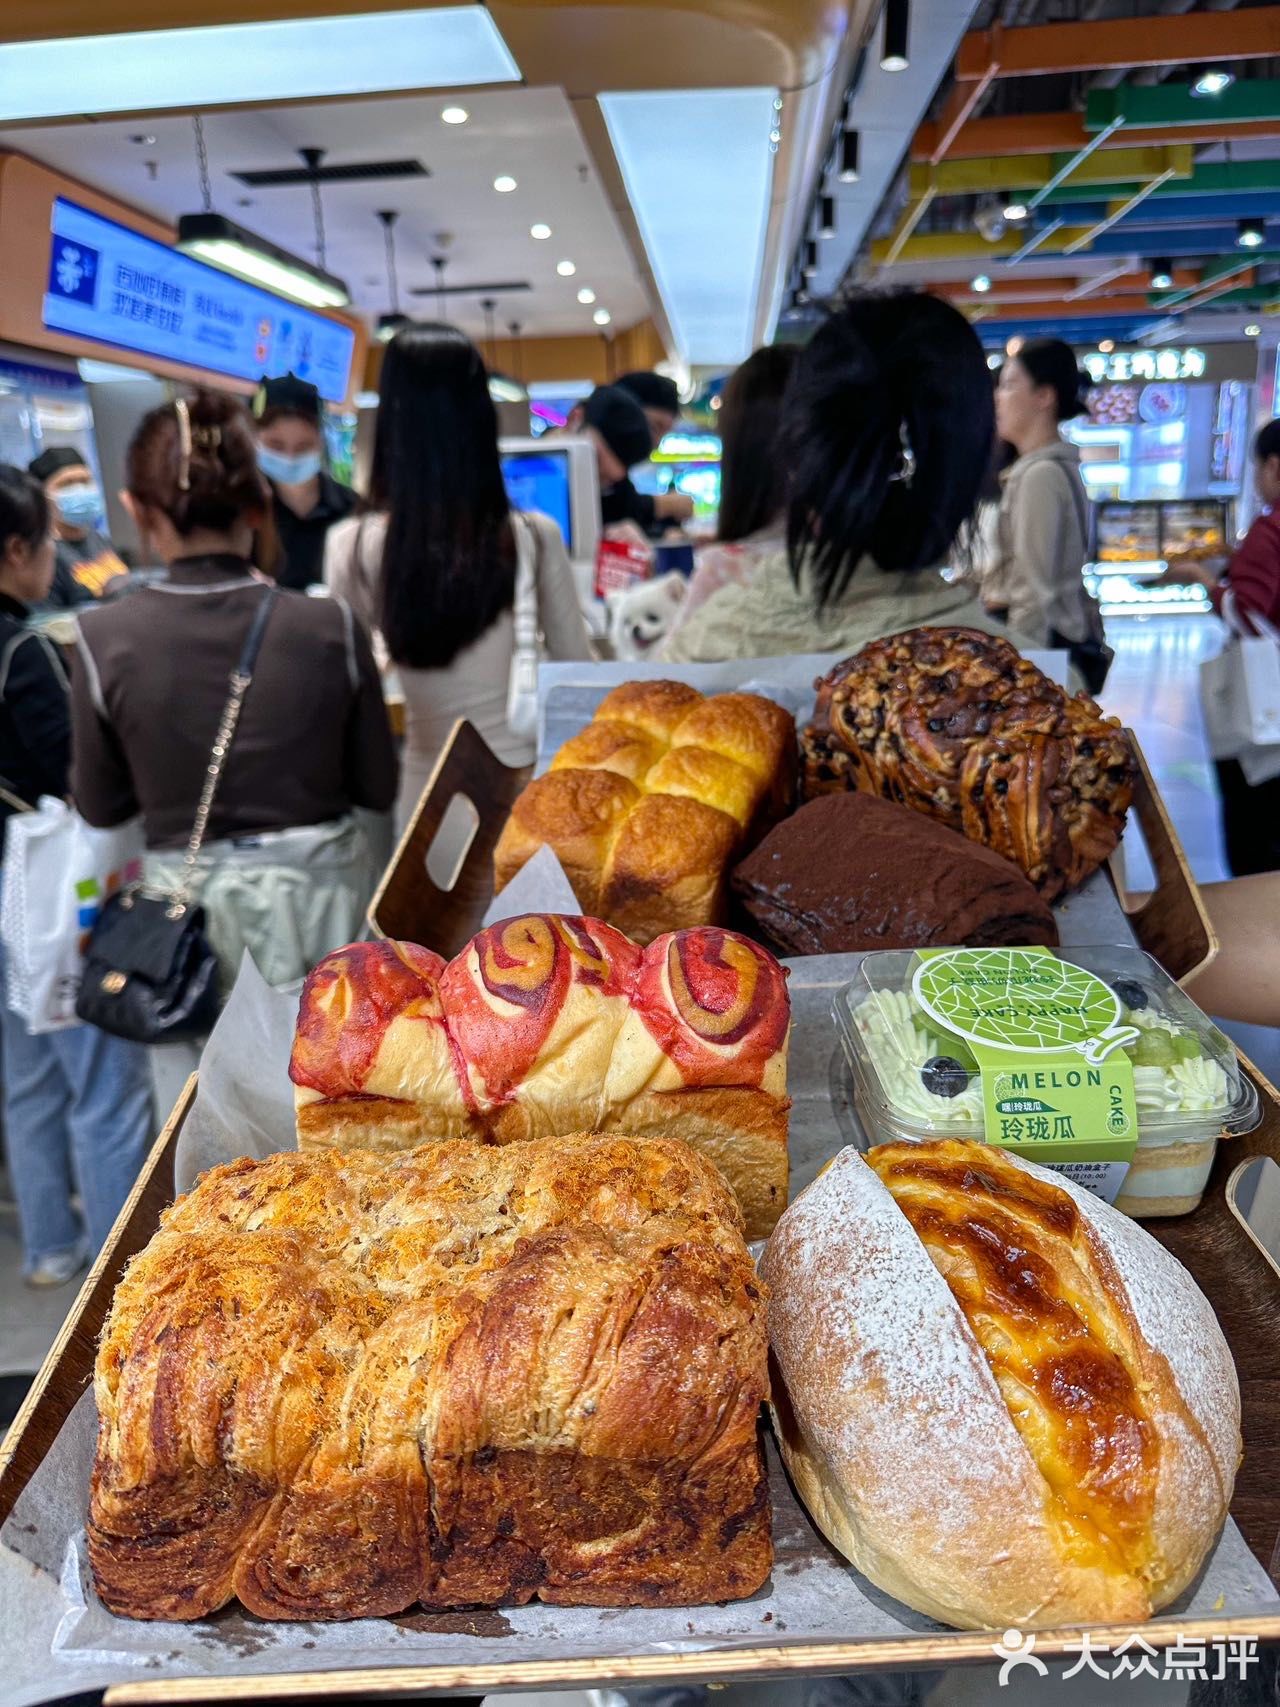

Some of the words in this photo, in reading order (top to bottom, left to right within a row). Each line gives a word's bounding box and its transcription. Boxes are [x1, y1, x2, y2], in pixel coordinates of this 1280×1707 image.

[970, 1007, 1020, 1018] CAKE
[1025, 1006, 1089, 1017] HAPPY
[1011, 1070, 1101, 1089] MELON
[1109, 1085, 1125, 1126] CAKE
[1000, 1115, 1076, 1141] 玲珑瓜
